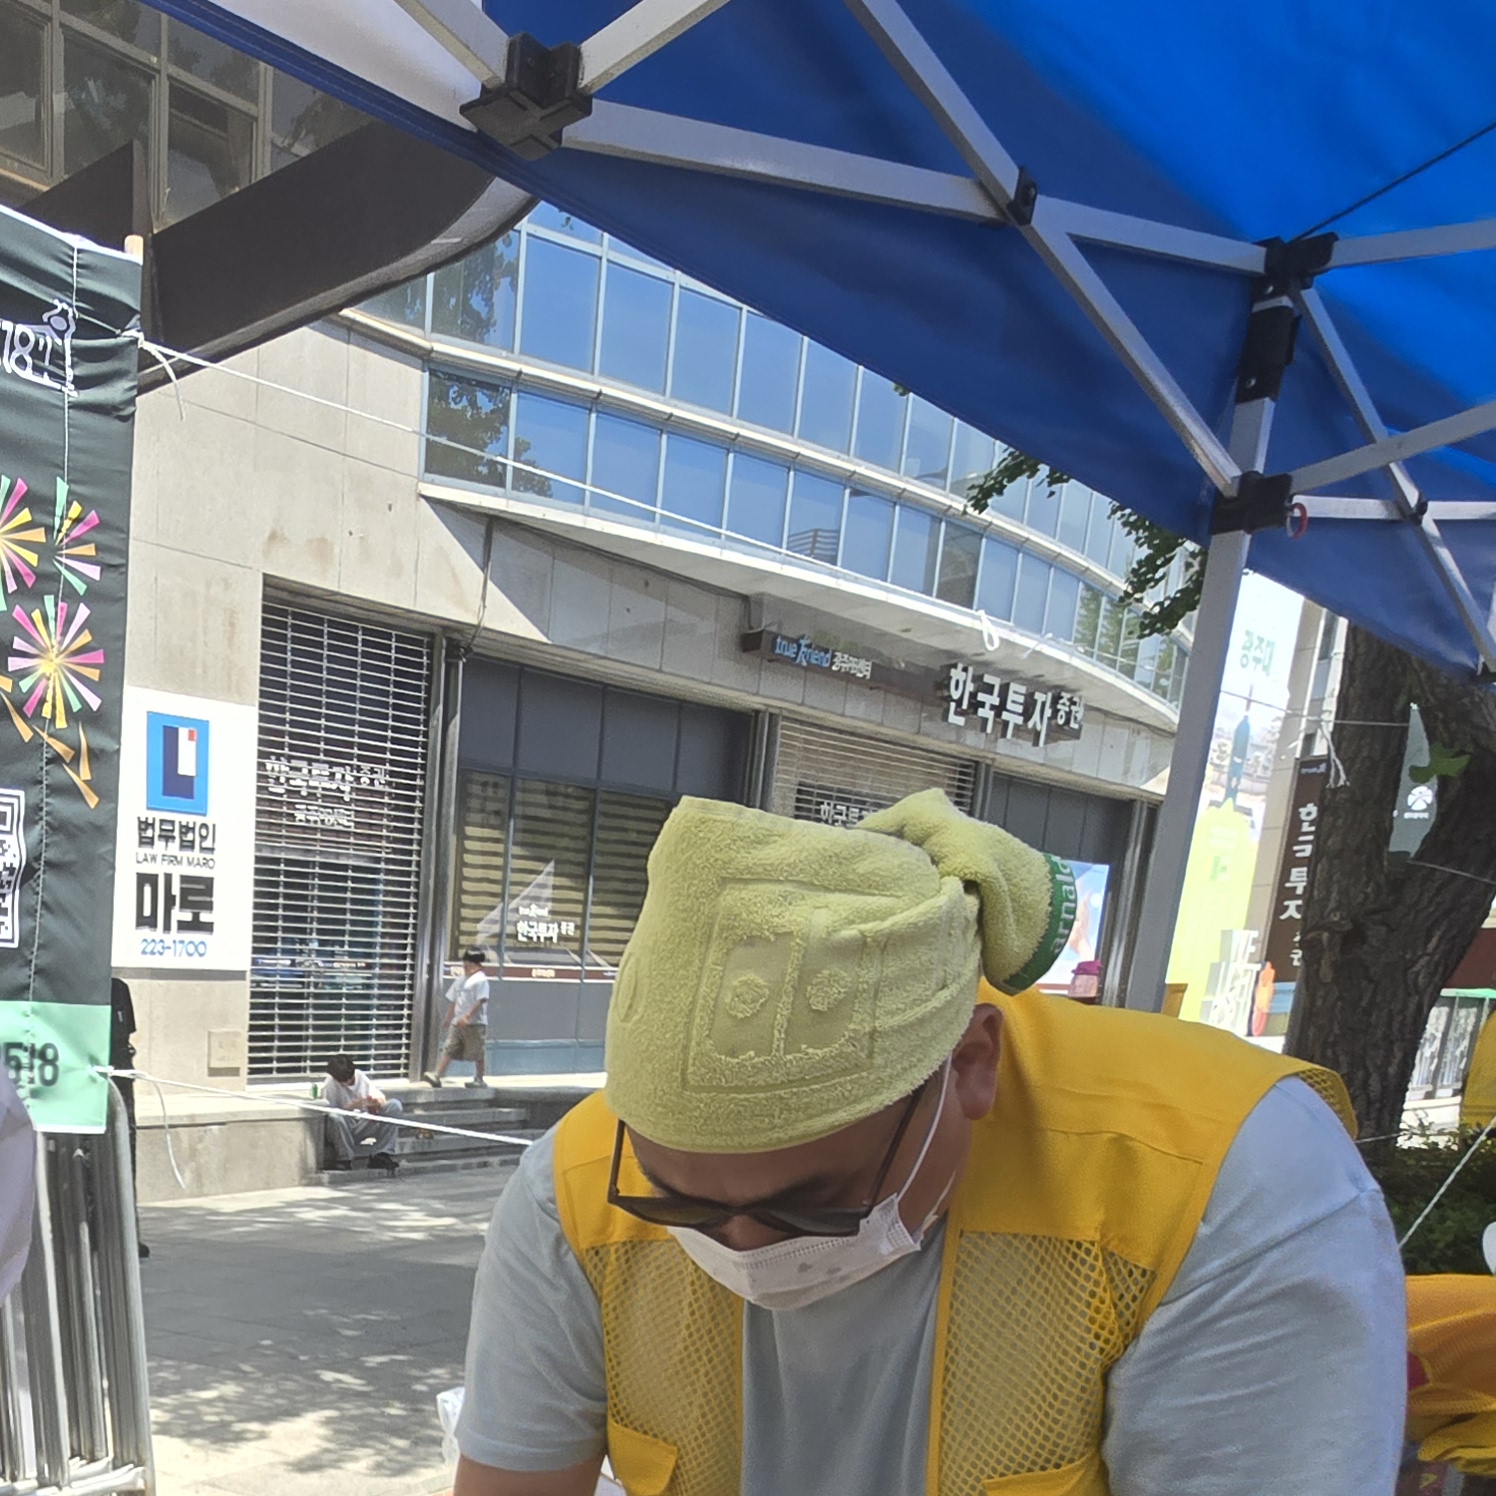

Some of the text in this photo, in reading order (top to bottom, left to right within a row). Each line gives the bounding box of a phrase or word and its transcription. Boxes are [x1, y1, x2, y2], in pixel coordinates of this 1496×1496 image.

[137, 816, 216, 855] 법무법인
[135, 852, 216, 870] LAW FIRM MARO
[135, 872, 215, 936] 마로
[140, 938, 207, 958] 223-1700
